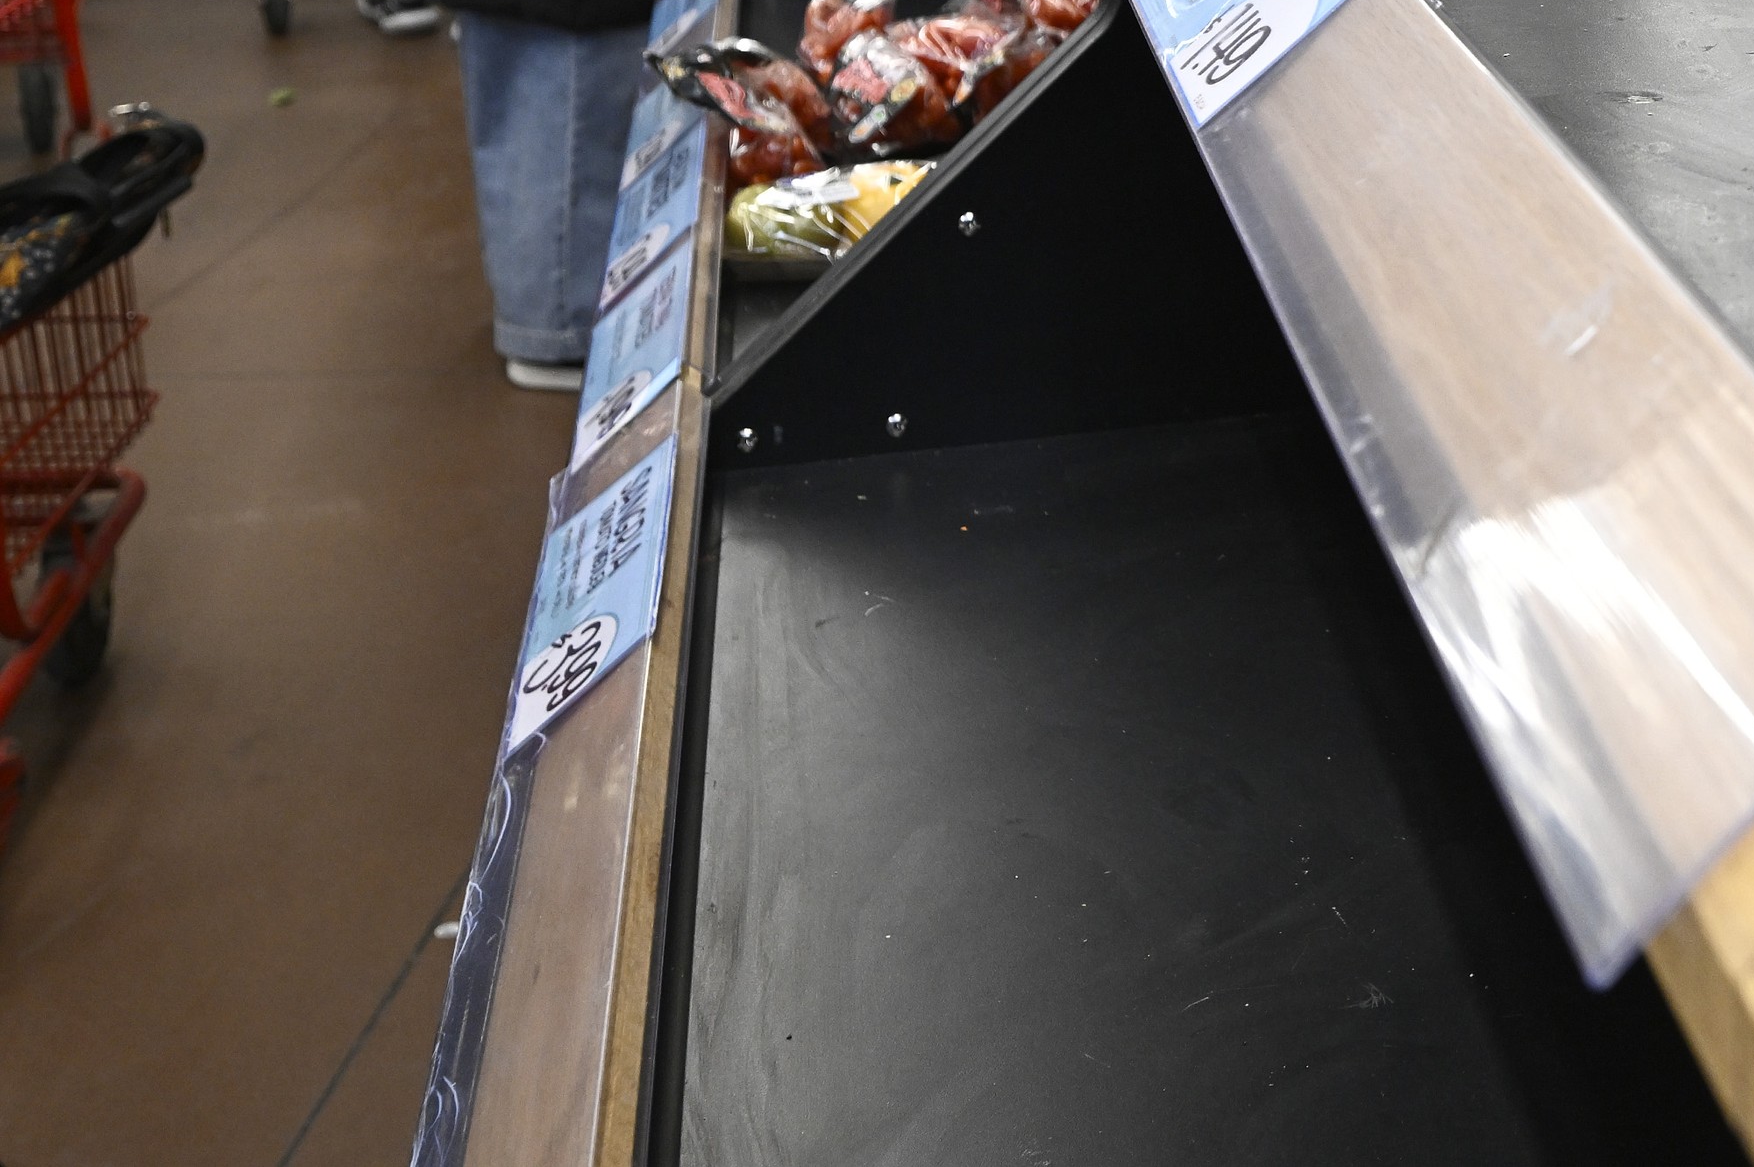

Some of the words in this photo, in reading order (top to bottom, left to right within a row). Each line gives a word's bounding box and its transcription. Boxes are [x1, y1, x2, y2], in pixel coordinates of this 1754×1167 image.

[594, 499, 617, 550] TOMATO
[608, 465, 653, 579] SANGRIA
[522, 620, 602, 712] $3.99
